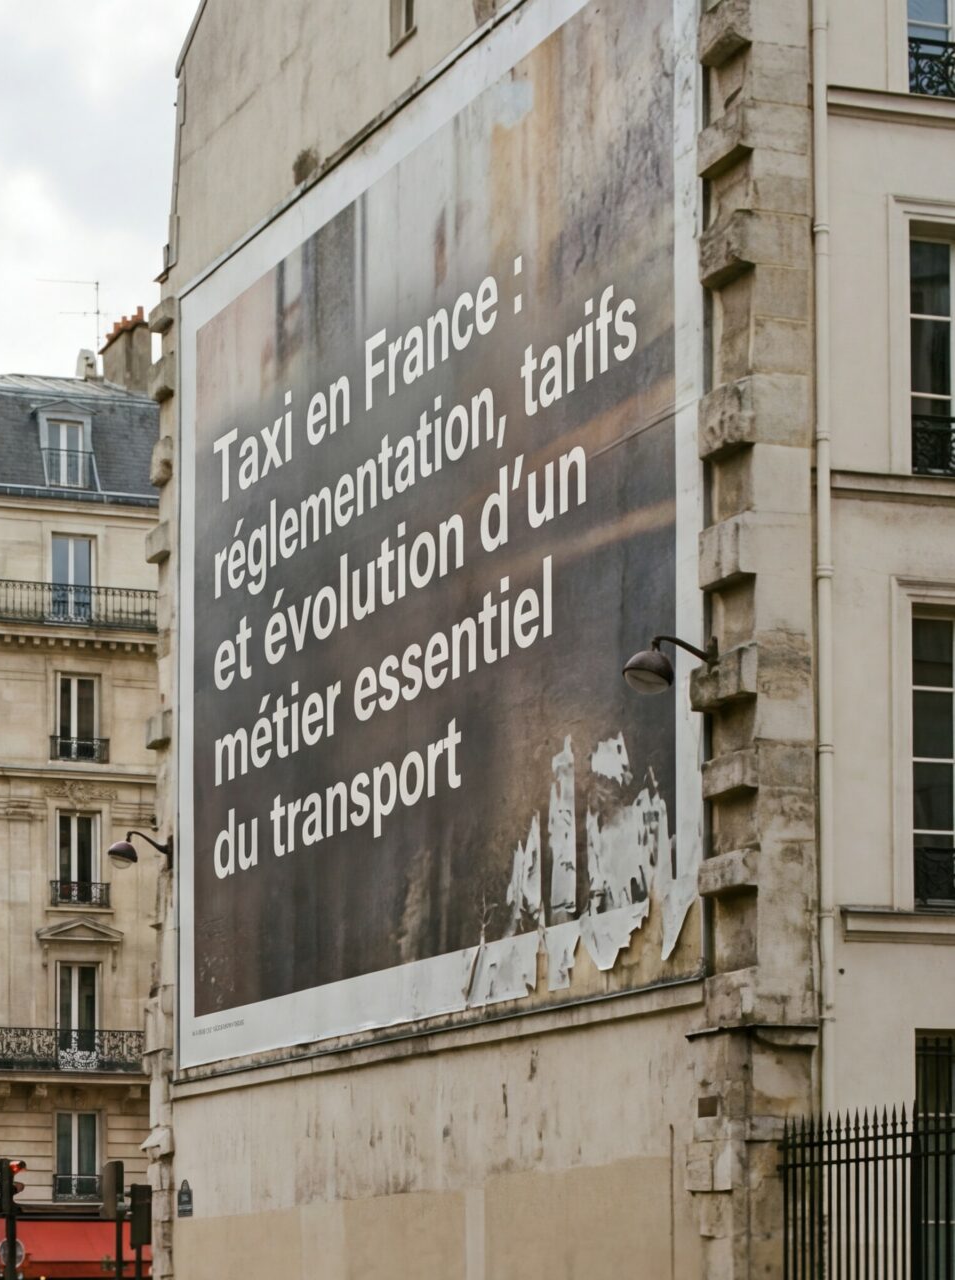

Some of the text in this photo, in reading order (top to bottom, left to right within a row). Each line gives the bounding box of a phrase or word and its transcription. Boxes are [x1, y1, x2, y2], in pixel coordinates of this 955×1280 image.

[213, 255, 522, 502] Taxi en France :
[214, 284, 638, 599] réglementation, tarifs
[214, 617, 251, 690] et
[264, 513, 464, 668] évolution
[214, 556, 554, 786] métier essentiel
[214, 718, 461, 880] du transport
